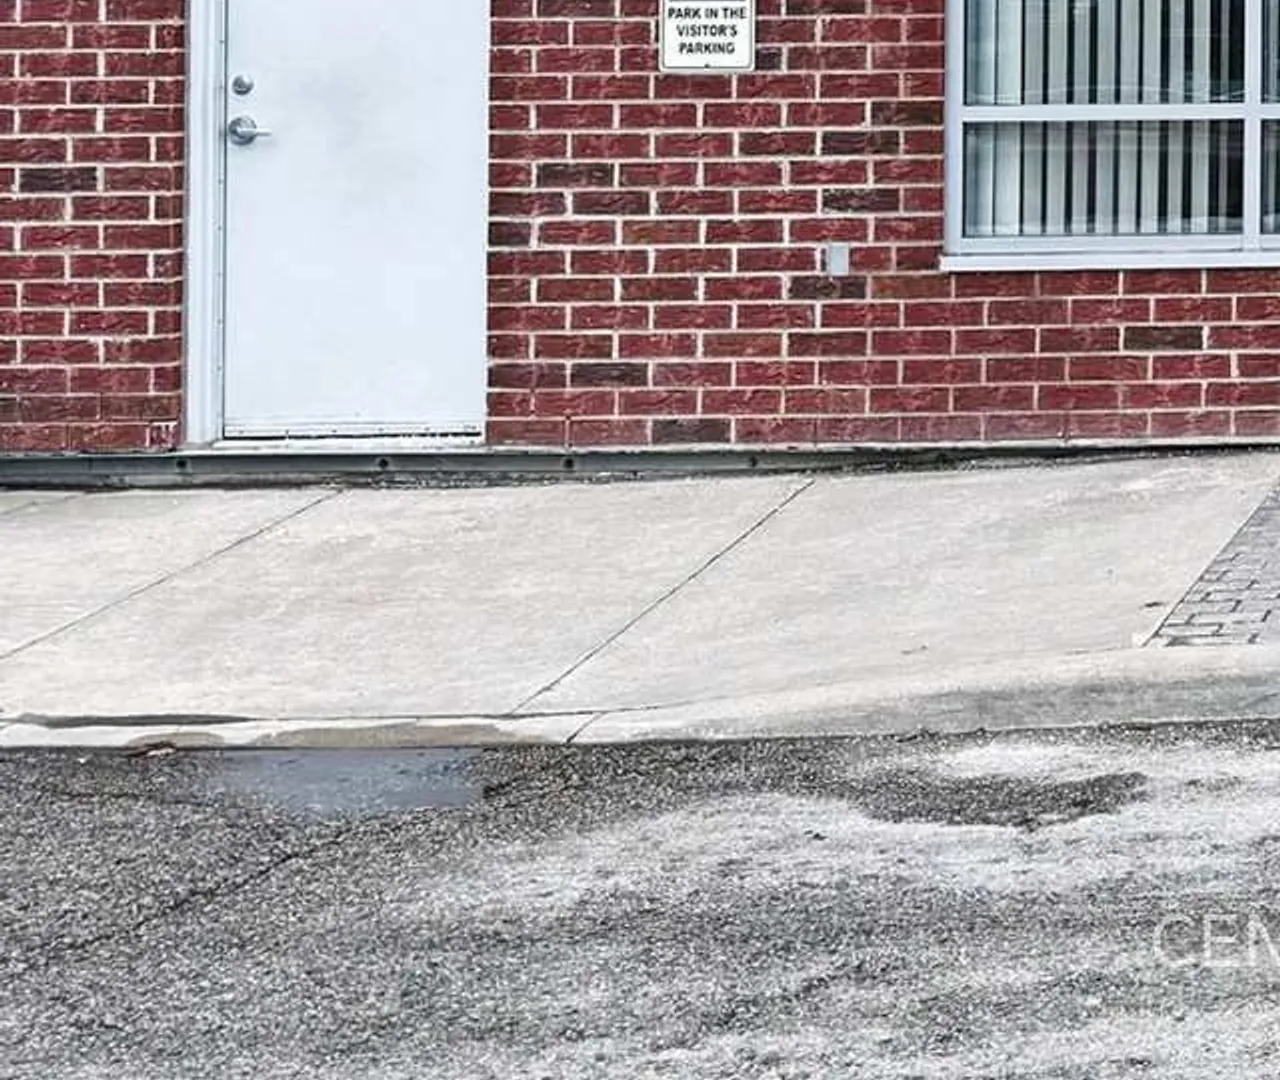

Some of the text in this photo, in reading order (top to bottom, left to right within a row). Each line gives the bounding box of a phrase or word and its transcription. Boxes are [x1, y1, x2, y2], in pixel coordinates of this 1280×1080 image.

[668, 7, 747, 19] PARK IN THE
[676, 24, 738, 37] VISITOR'S
[679, 42, 735, 54] PARKING
